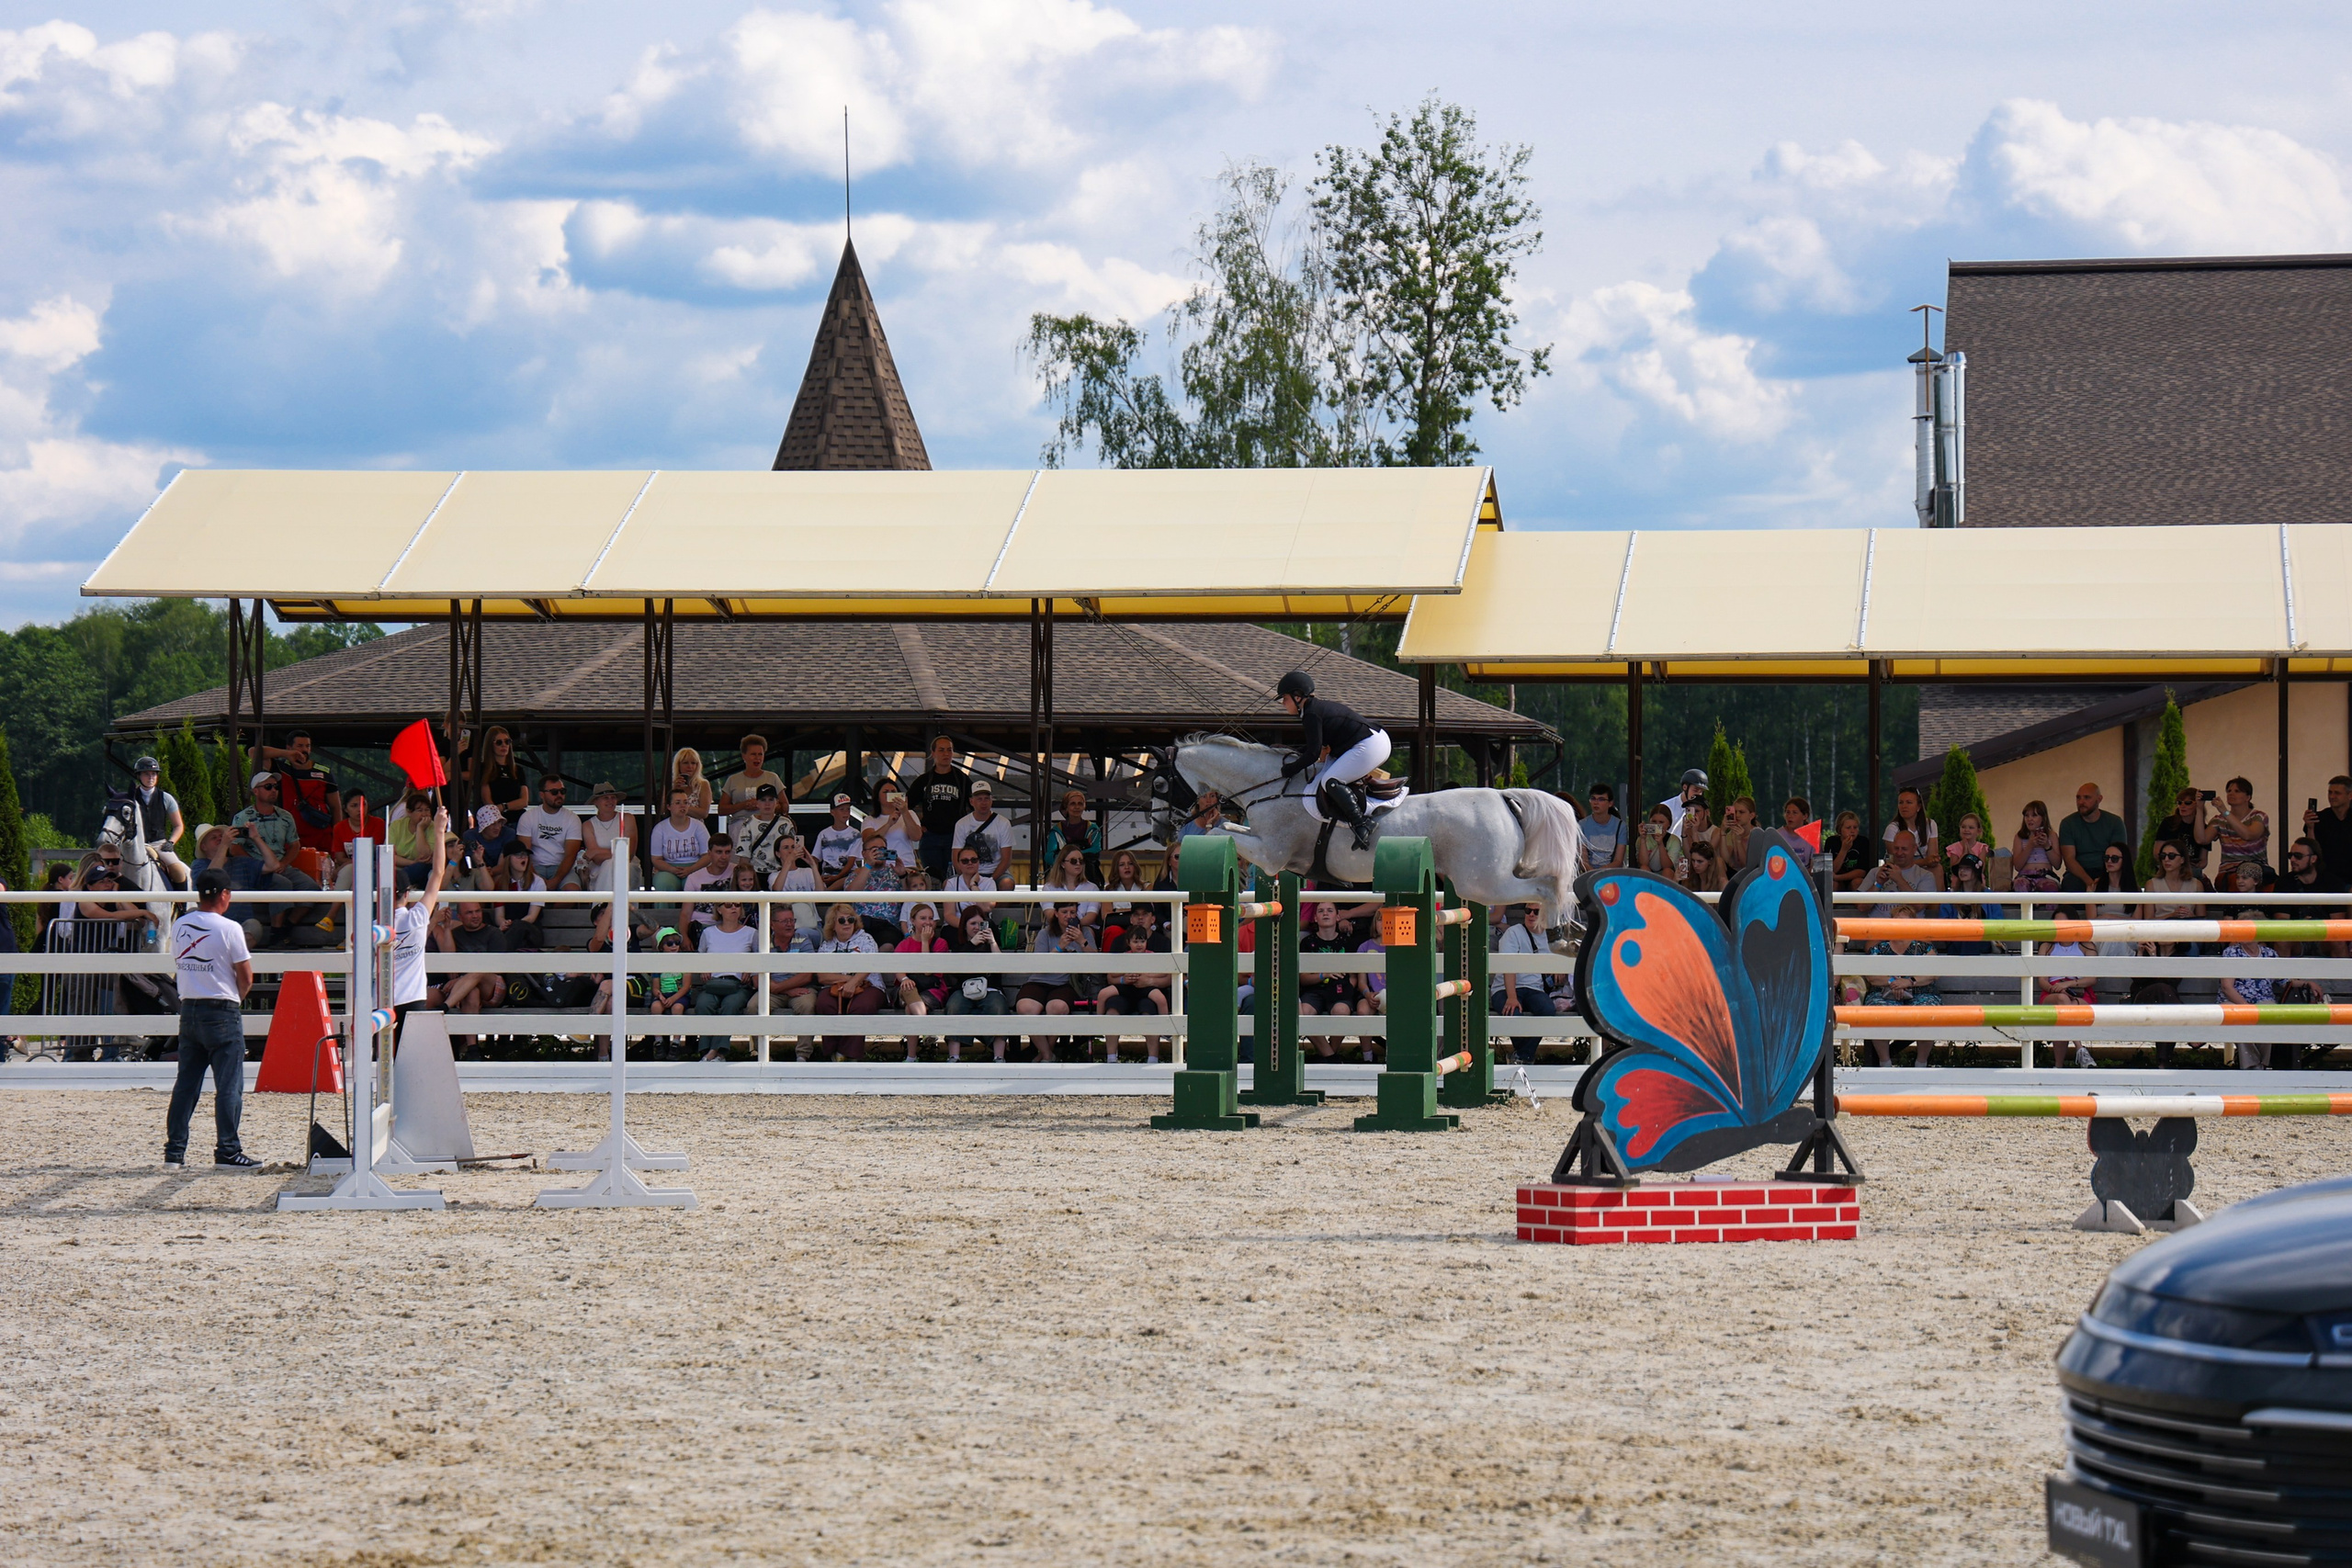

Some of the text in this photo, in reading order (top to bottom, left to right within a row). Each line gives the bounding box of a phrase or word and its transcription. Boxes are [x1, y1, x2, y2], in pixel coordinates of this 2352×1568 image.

[923, 784, 959, 799] STON
[667, 836, 696, 854] OVER
[2053, 1499, 2102, 1539] НОВЫЙ
